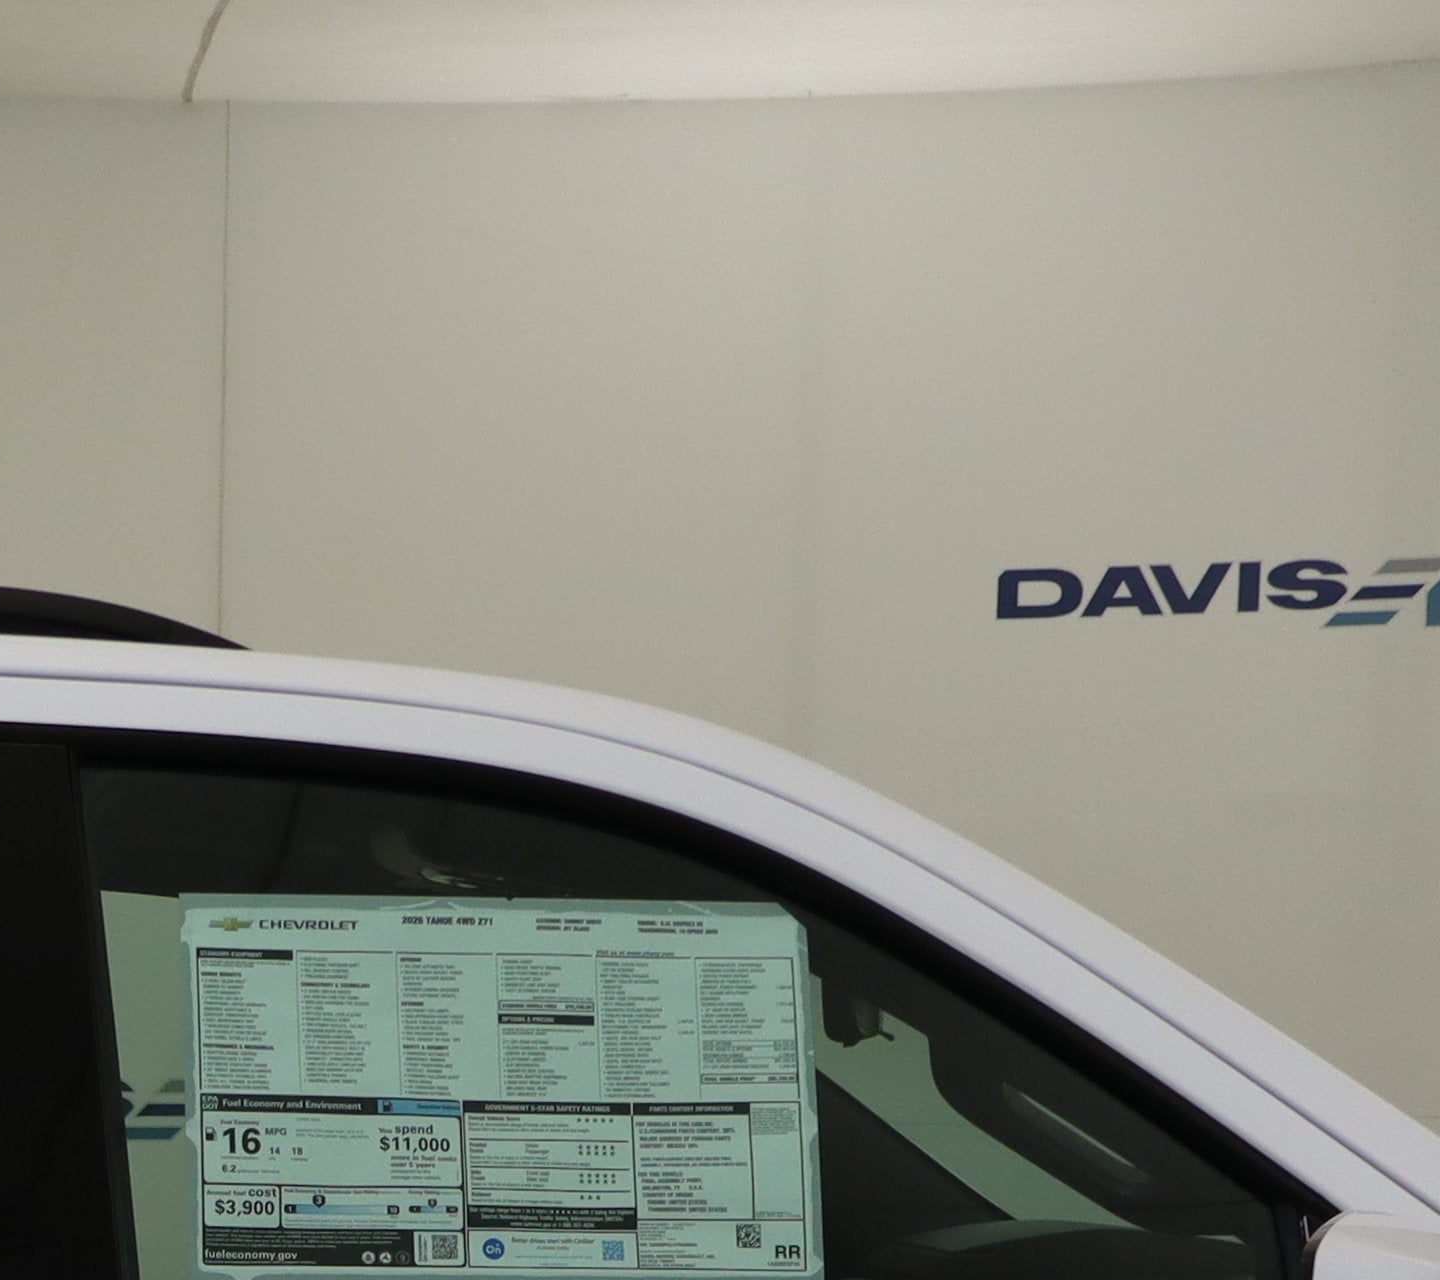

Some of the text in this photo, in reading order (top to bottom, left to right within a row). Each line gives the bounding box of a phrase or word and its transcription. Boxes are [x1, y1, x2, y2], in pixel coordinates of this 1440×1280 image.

[995, 560, 1346, 620] DAVIS
[259, 919, 359, 931] CHEVROLET
[425, 917, 453, 926] TAHOE
[456, 917, 476, 926] 4WD
[477, 918, 494, 926] Z71
[202, 1095, 218, 1103] EPA
[222, 1098, 362, 1111] Fuel Economy and Environment
[485, 1104, 530, 1112] GOVERNMENT
[394, 1124, 433, 1136] spend
[222, 1127, 262, 1155] 16
[264, 1127, 287, 1136] MPG
[379, 1135, 451, 1153] $11,000
[269, 1146, 281, 1155] 14
[291, 1146, 303, 1155] 18
[221, 1164, 236, 1173] 6.2
[248, 1188, 277, 1197] cost
[316, 1196, 322, 1204] 3
[214, 1198, 275, 1217] $3,900
[485, 1243, 502, 1254] On
[775, 1245, 801, 1260] RR
[204, 1248, 297, 1262] fueleconomy.gov
